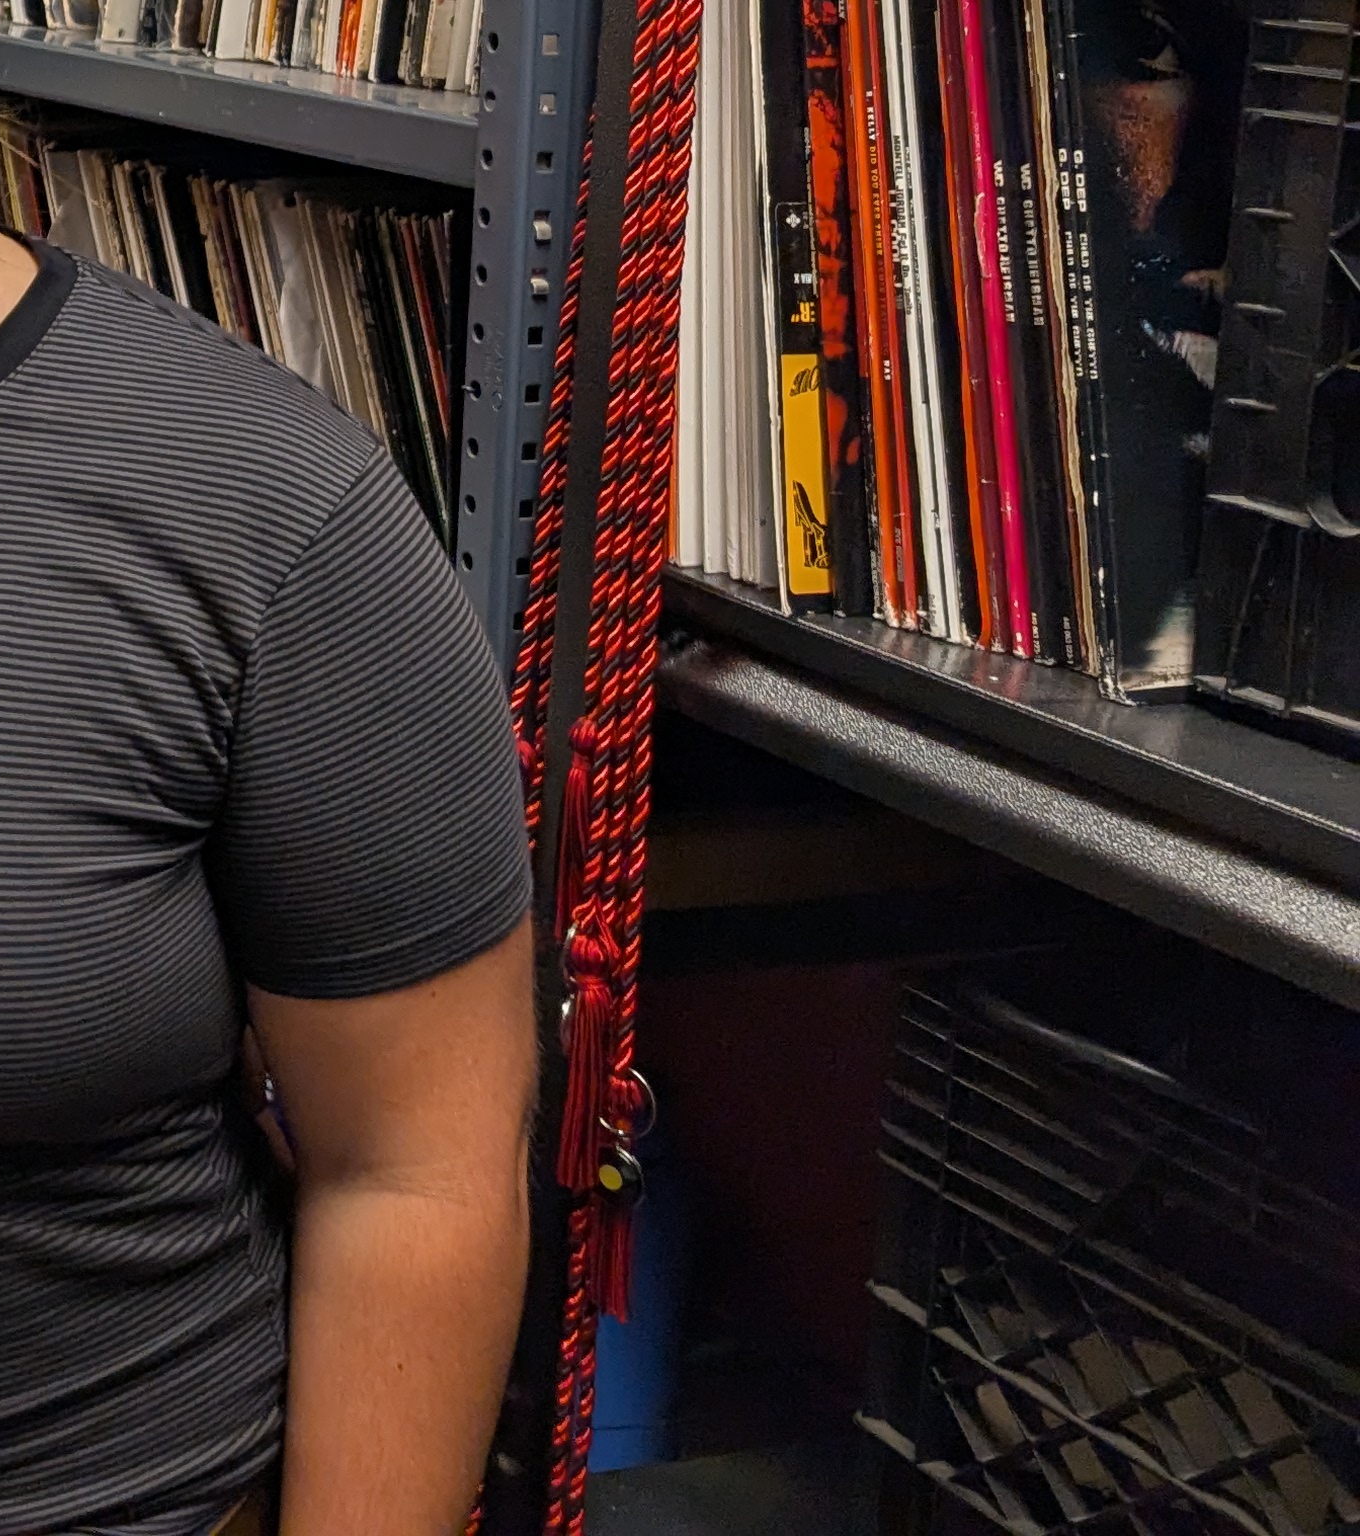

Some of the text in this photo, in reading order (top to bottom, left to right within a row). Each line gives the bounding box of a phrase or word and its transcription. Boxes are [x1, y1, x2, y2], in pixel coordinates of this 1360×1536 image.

[866, 106, 876, 141] KELLY
[869, 146, 878, 165] DID
[893, 135, 905, 180] MONTELL
[871, 168, 880, 188] YOU
[993, 159, 1005, 188] WC
[1020, 163, 1032, 191] WC
[872, 193, 882, 220] EVER
[1061, 171, 1071, 211] DEP
[1076, 173, 1088, 213] DEP
[874, 223, 884, 256] THINK
